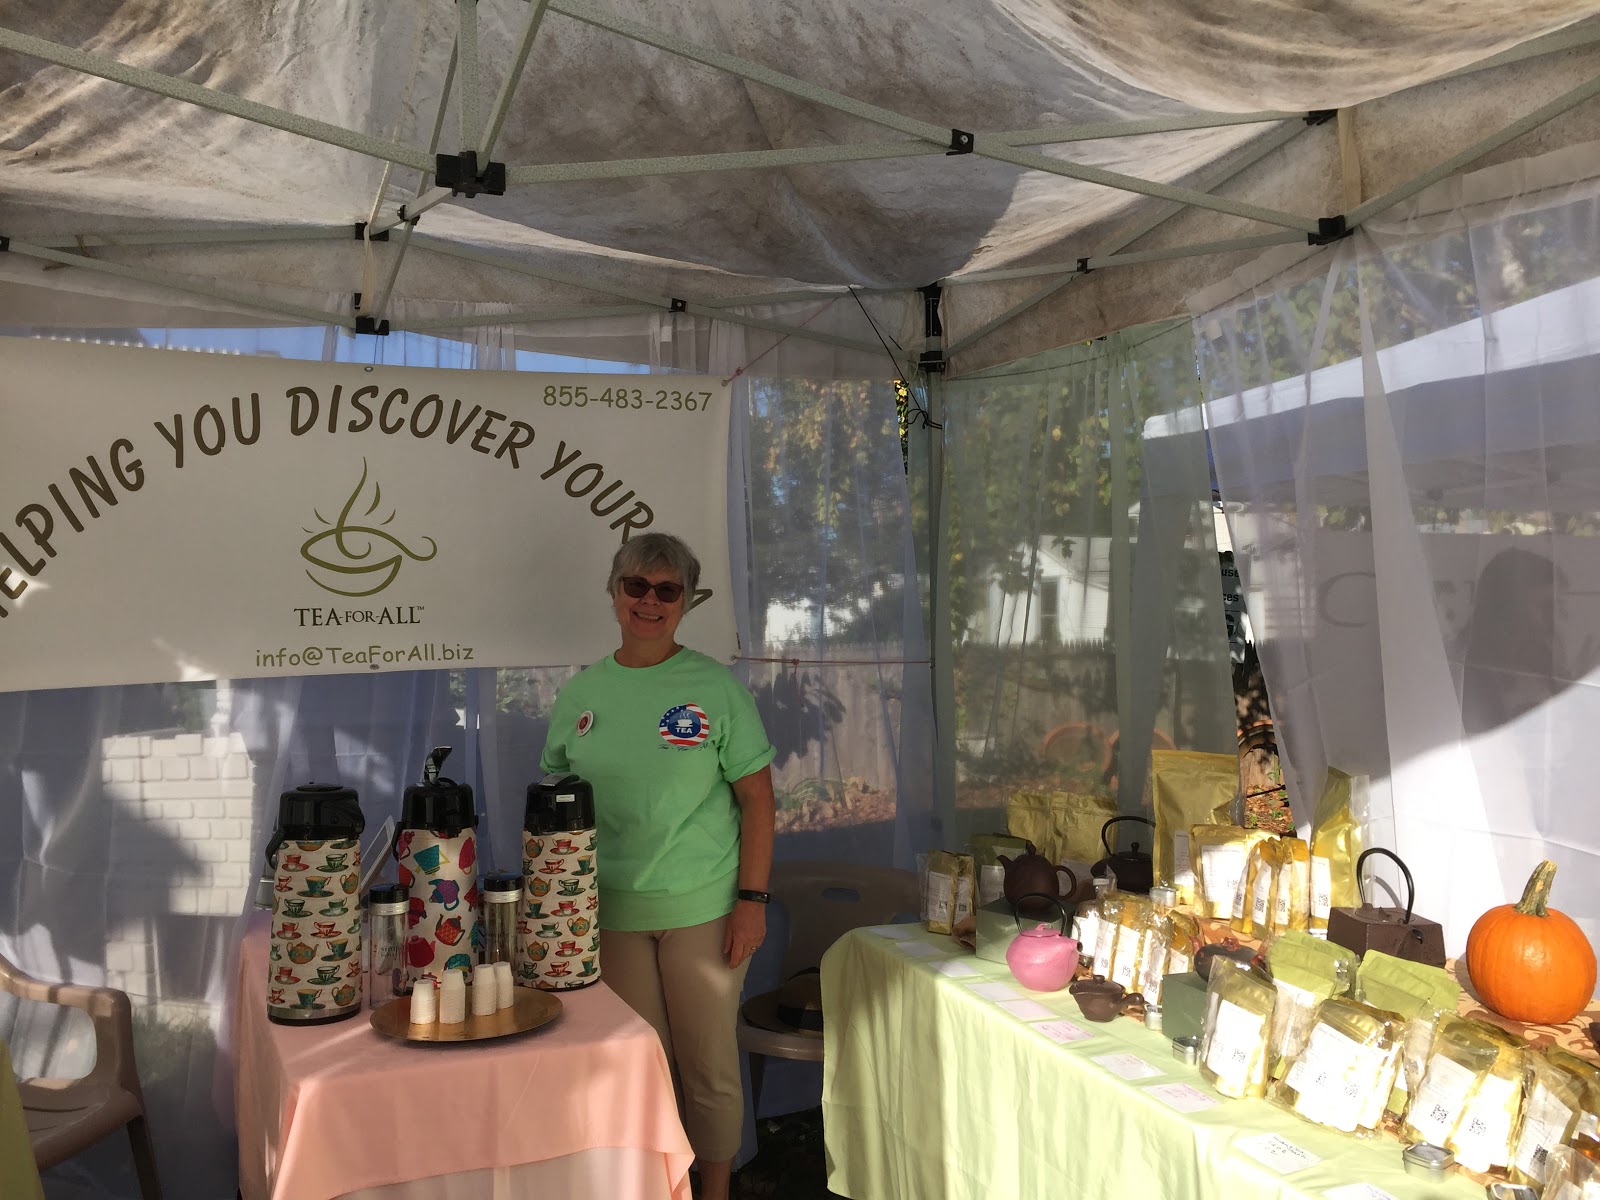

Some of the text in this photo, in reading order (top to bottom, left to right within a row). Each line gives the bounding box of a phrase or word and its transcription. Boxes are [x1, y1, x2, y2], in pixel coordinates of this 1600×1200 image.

[543, 385, 713, 412] 855-483-2367
[0, 384, 655, 618] ELPING YOU DISCOVER YOUR
[255, 643, 474, 667] info@TeaForAll.biz
